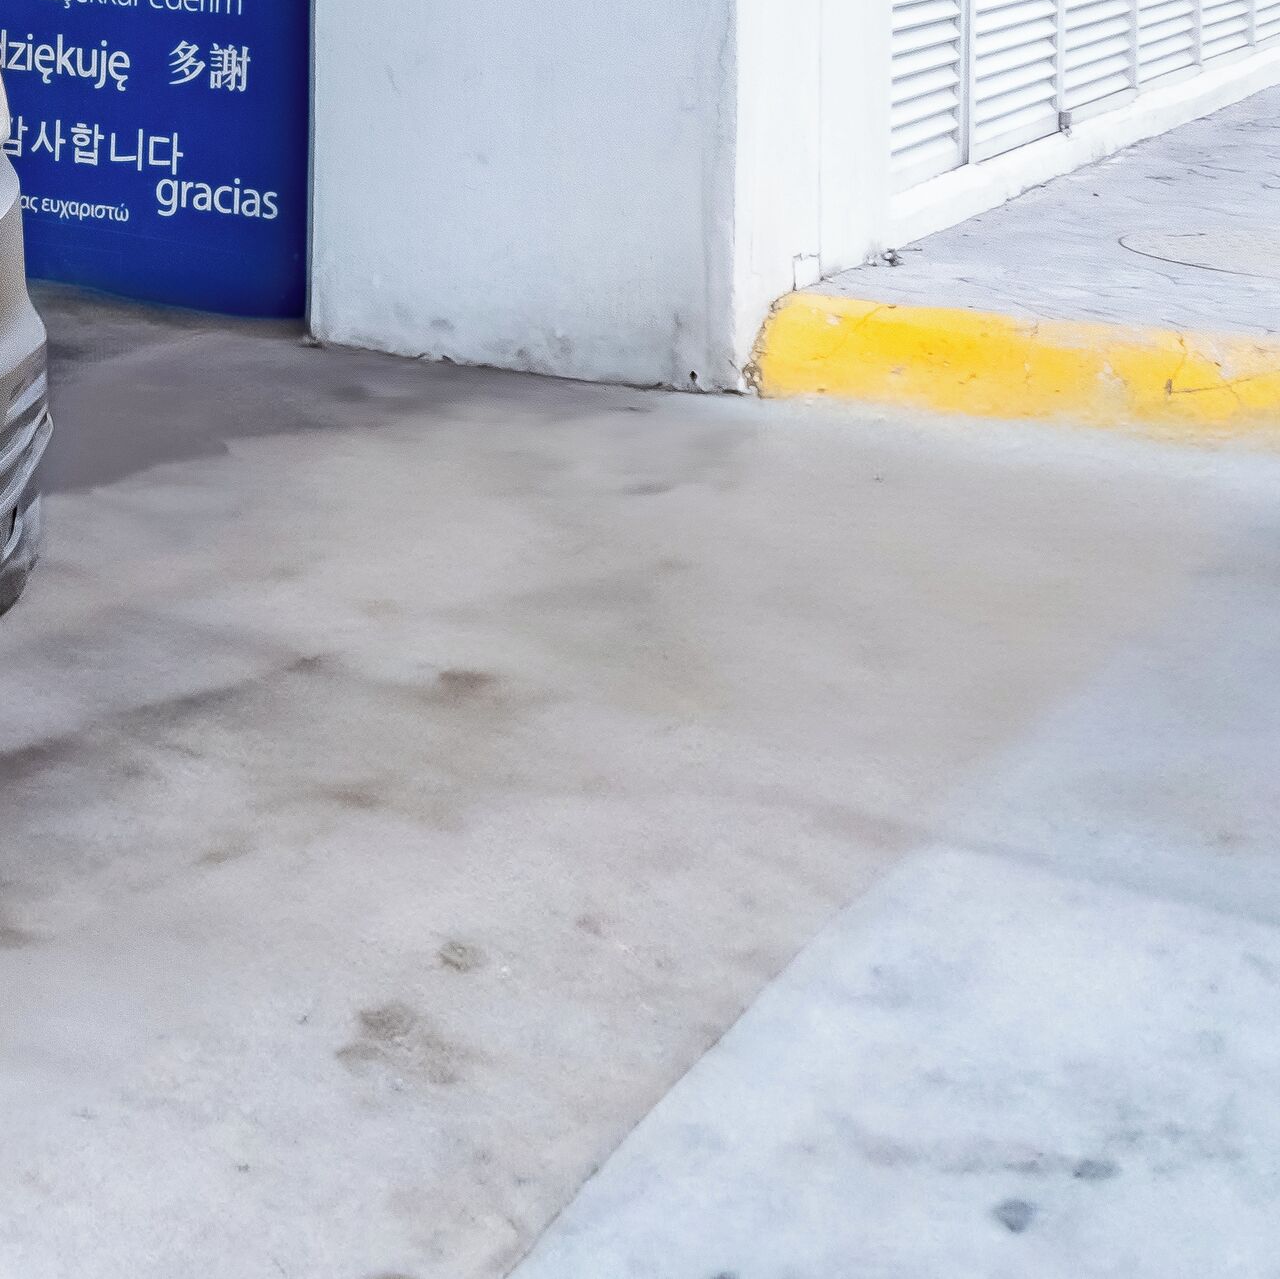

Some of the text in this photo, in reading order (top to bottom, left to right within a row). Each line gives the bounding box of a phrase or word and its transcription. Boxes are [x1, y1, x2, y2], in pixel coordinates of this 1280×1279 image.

[168, 40, 251, 92] 多謝
[20, 195, 130, 222] ας ευχαριστώ
[156, 177, 279, 220] gracias
